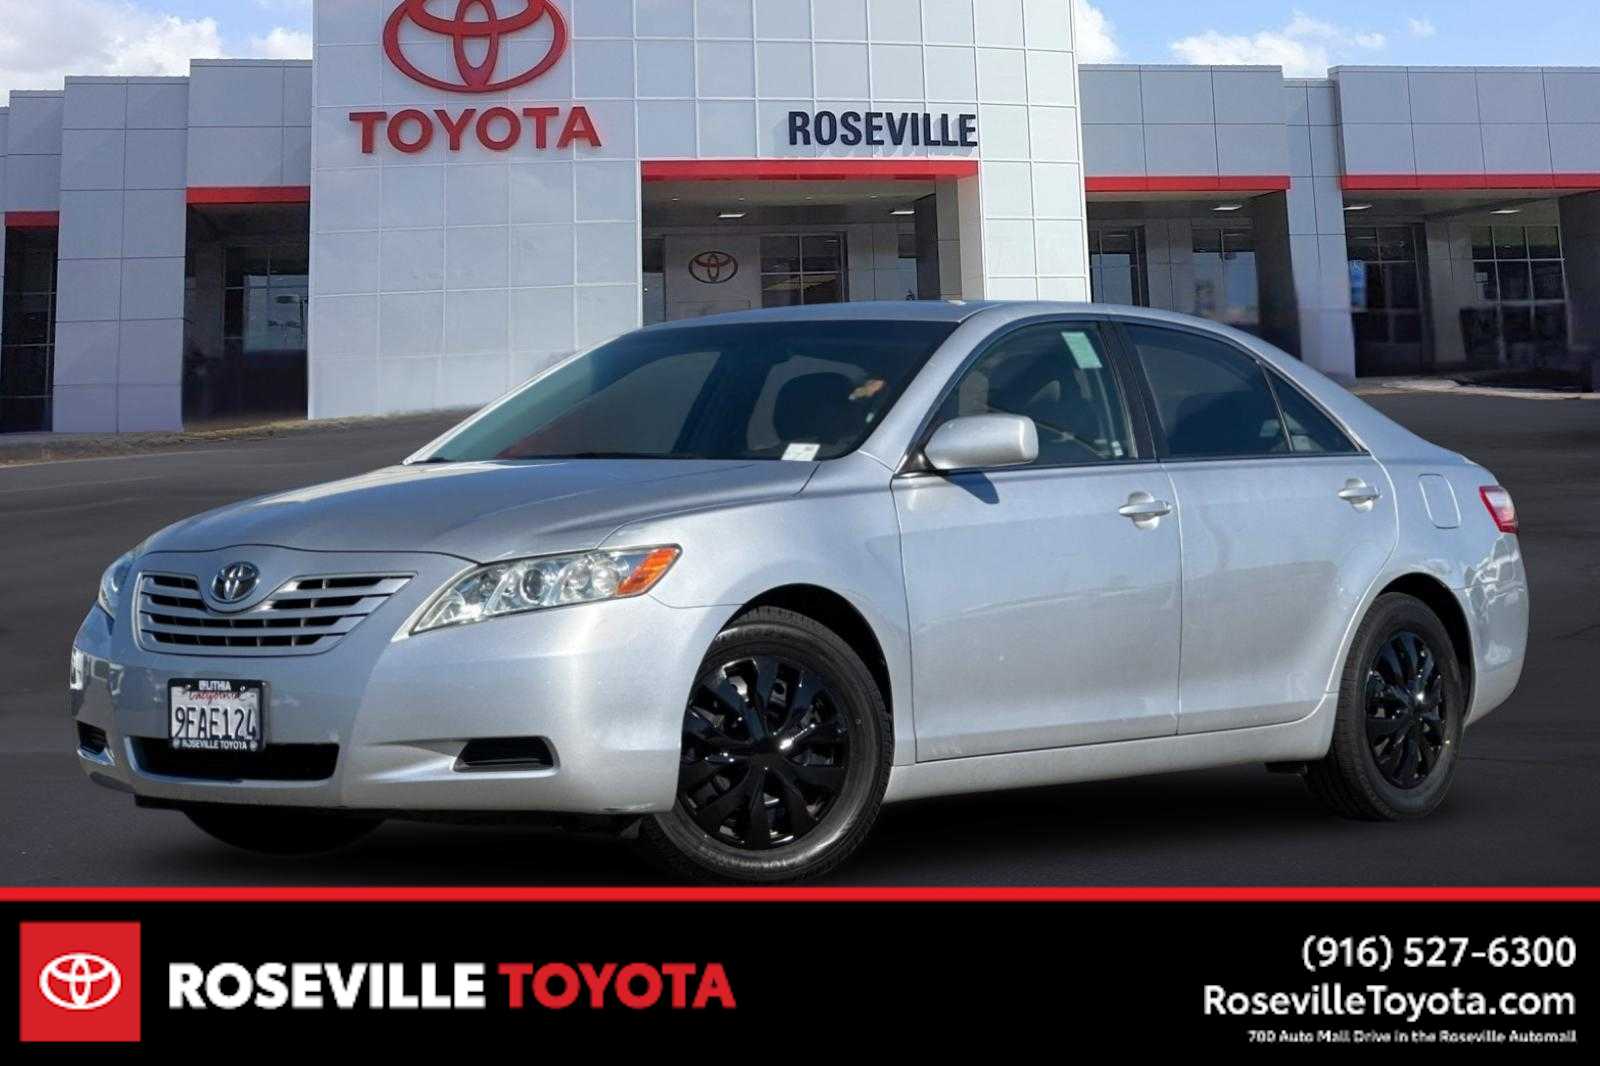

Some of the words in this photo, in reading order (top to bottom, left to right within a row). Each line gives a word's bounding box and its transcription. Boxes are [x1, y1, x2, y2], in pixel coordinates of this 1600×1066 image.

[349, 106, 602, 154] TOYOTA
[788, 110, 978, 147] ROSEVILLE
[175, 707, 256, 738] 9FAE124
[220, 740, 248, 750] TOYOTA
